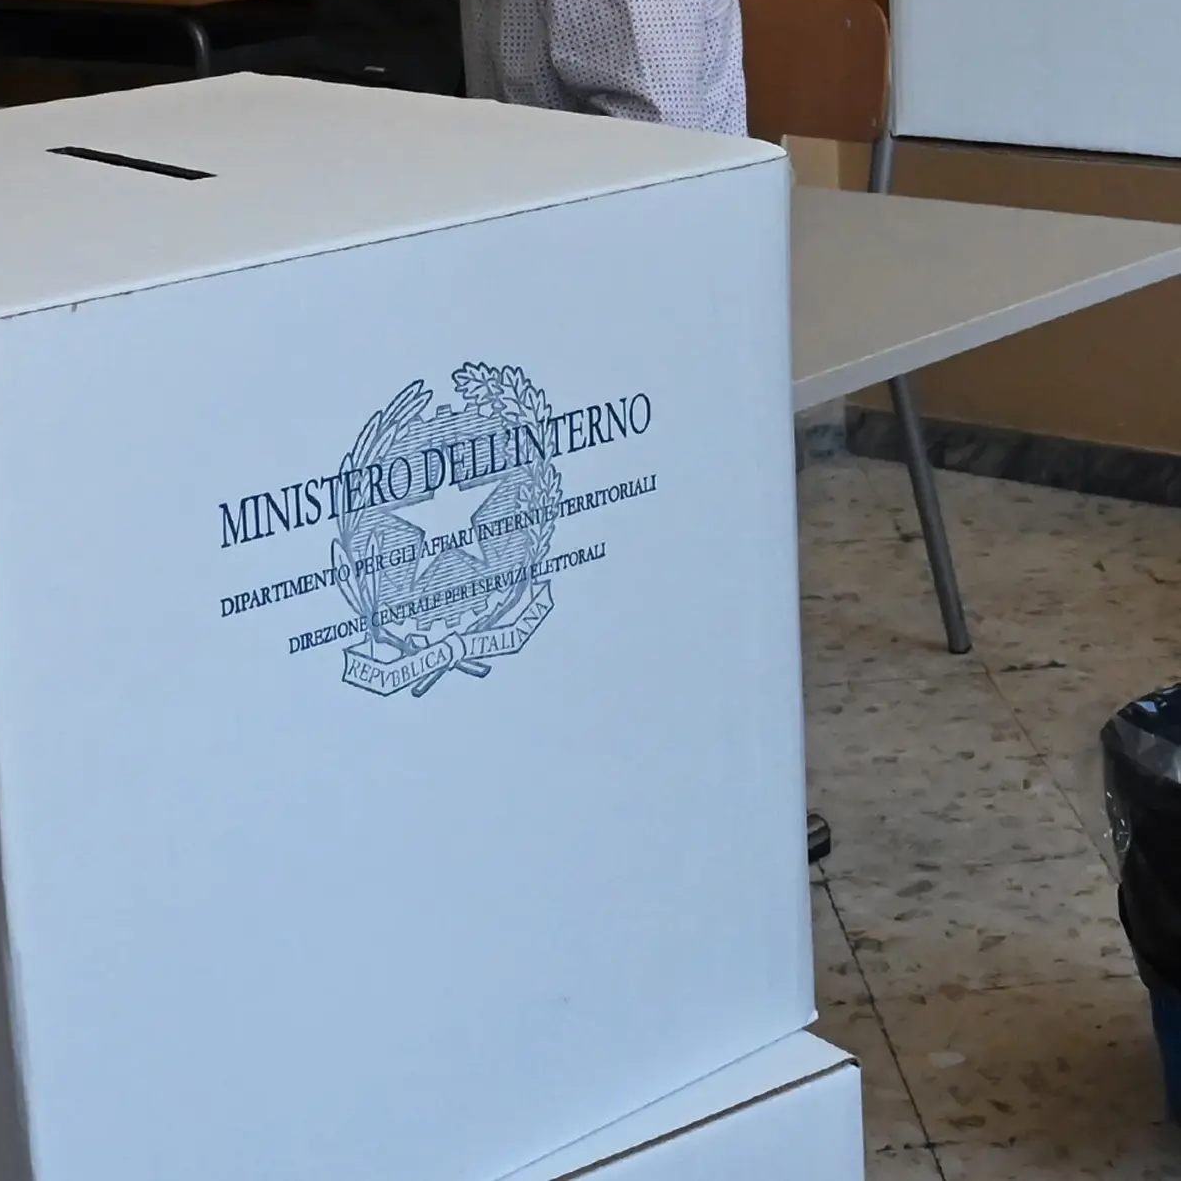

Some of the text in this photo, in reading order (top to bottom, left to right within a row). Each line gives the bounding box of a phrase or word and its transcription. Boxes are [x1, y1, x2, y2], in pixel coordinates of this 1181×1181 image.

[219, 393, 651, 548] MINISTERO DELL'INTERNO
[220, 564, 351, 617] DIPARTIMENTO
[355, 553, 385, 578] PER
[389, 545, 417, 567] GLI
[420, 528, 474, 559] AFFARI
[477, 508, 540, 541] INTERNI
[558, 475, 657, 519] TERRITORIALI
[289, 616, 369, 654] DIREZIONE
[372, 592, 442, 628] CENTRALE
[444, 586, 469, 605] PER
[478, 566, 529, 594] SERVIZI
[530, 542, 607, 579] ELETTORALI
[347, 602, 549, 688] REPVBBLICA ITALIANA
